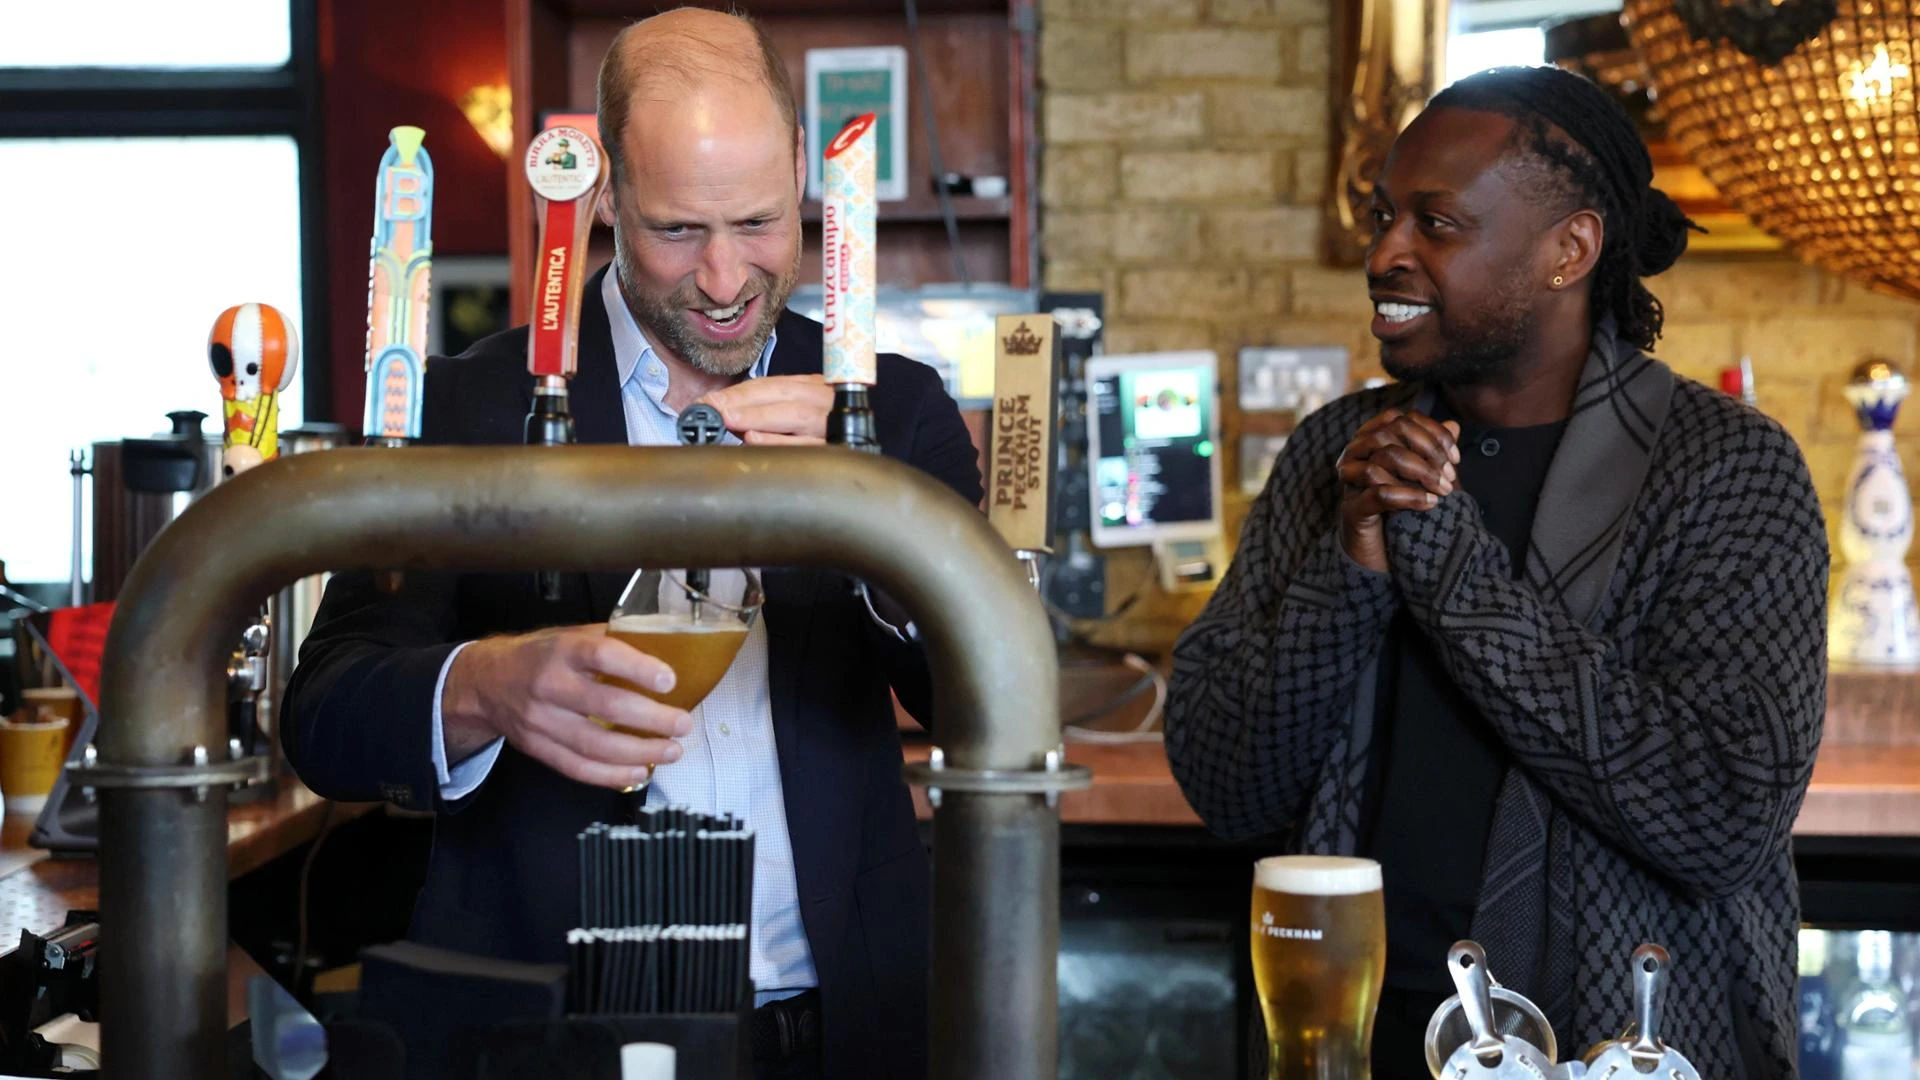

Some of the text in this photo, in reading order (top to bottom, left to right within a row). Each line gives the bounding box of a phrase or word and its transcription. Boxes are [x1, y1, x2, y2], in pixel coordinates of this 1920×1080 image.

[529, 128, 596, 168] BIRRA MORETTI
[384, 166, 429, 220] B
[542, 246, 567, 331] L'AUTENTICA
[824, 205, 839, 333] Cruzcampo
[995, 397, 1016, 506] PRINCE
[1013, 395, 1031, 511] PECKHAM
[1027, 417, 1042, 490] STOUT
[1267, 926, 1323, 941] PECKHAM
